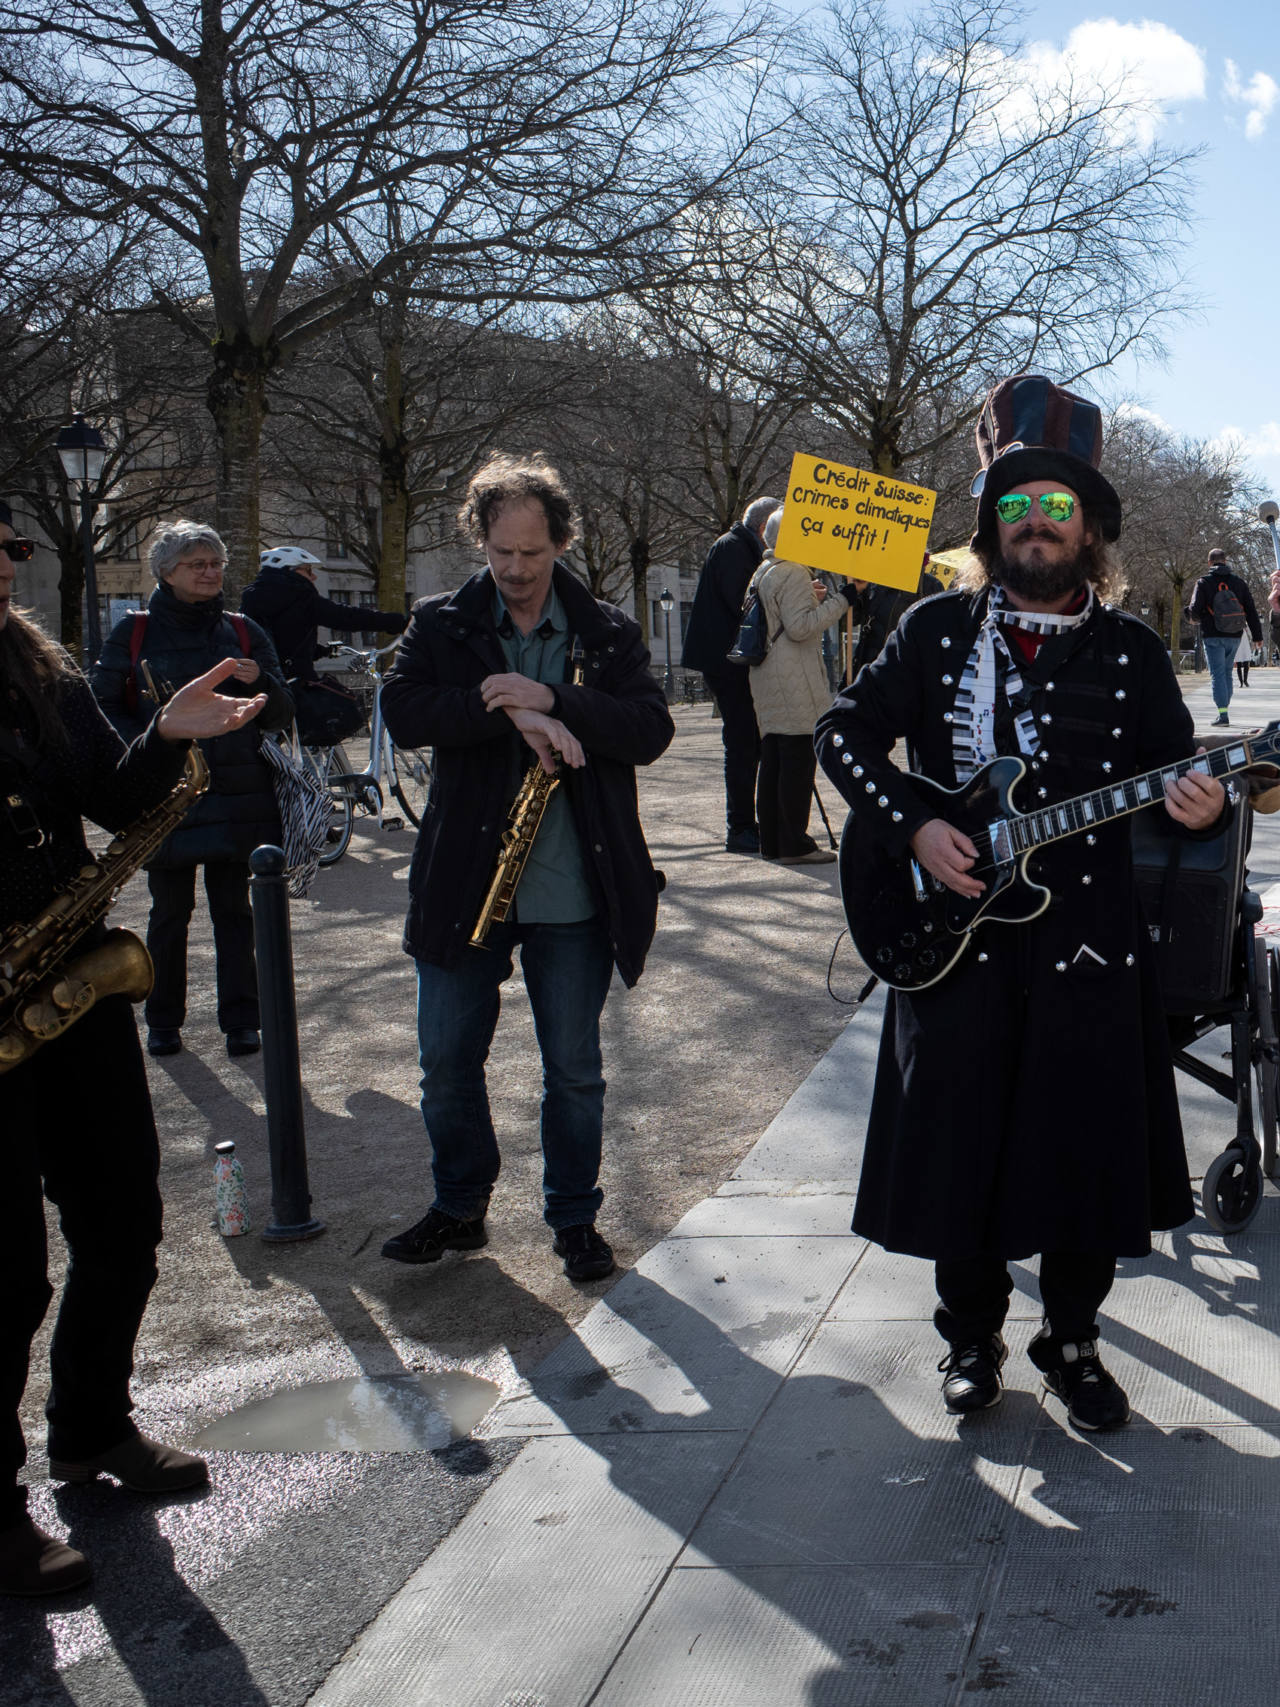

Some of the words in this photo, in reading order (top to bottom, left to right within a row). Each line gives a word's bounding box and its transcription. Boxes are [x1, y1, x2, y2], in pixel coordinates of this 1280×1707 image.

[813, 463, 870, 493] Crédit
[855, 497, 930, 533] climatiques
[832, 522, 877, 551] suffit
